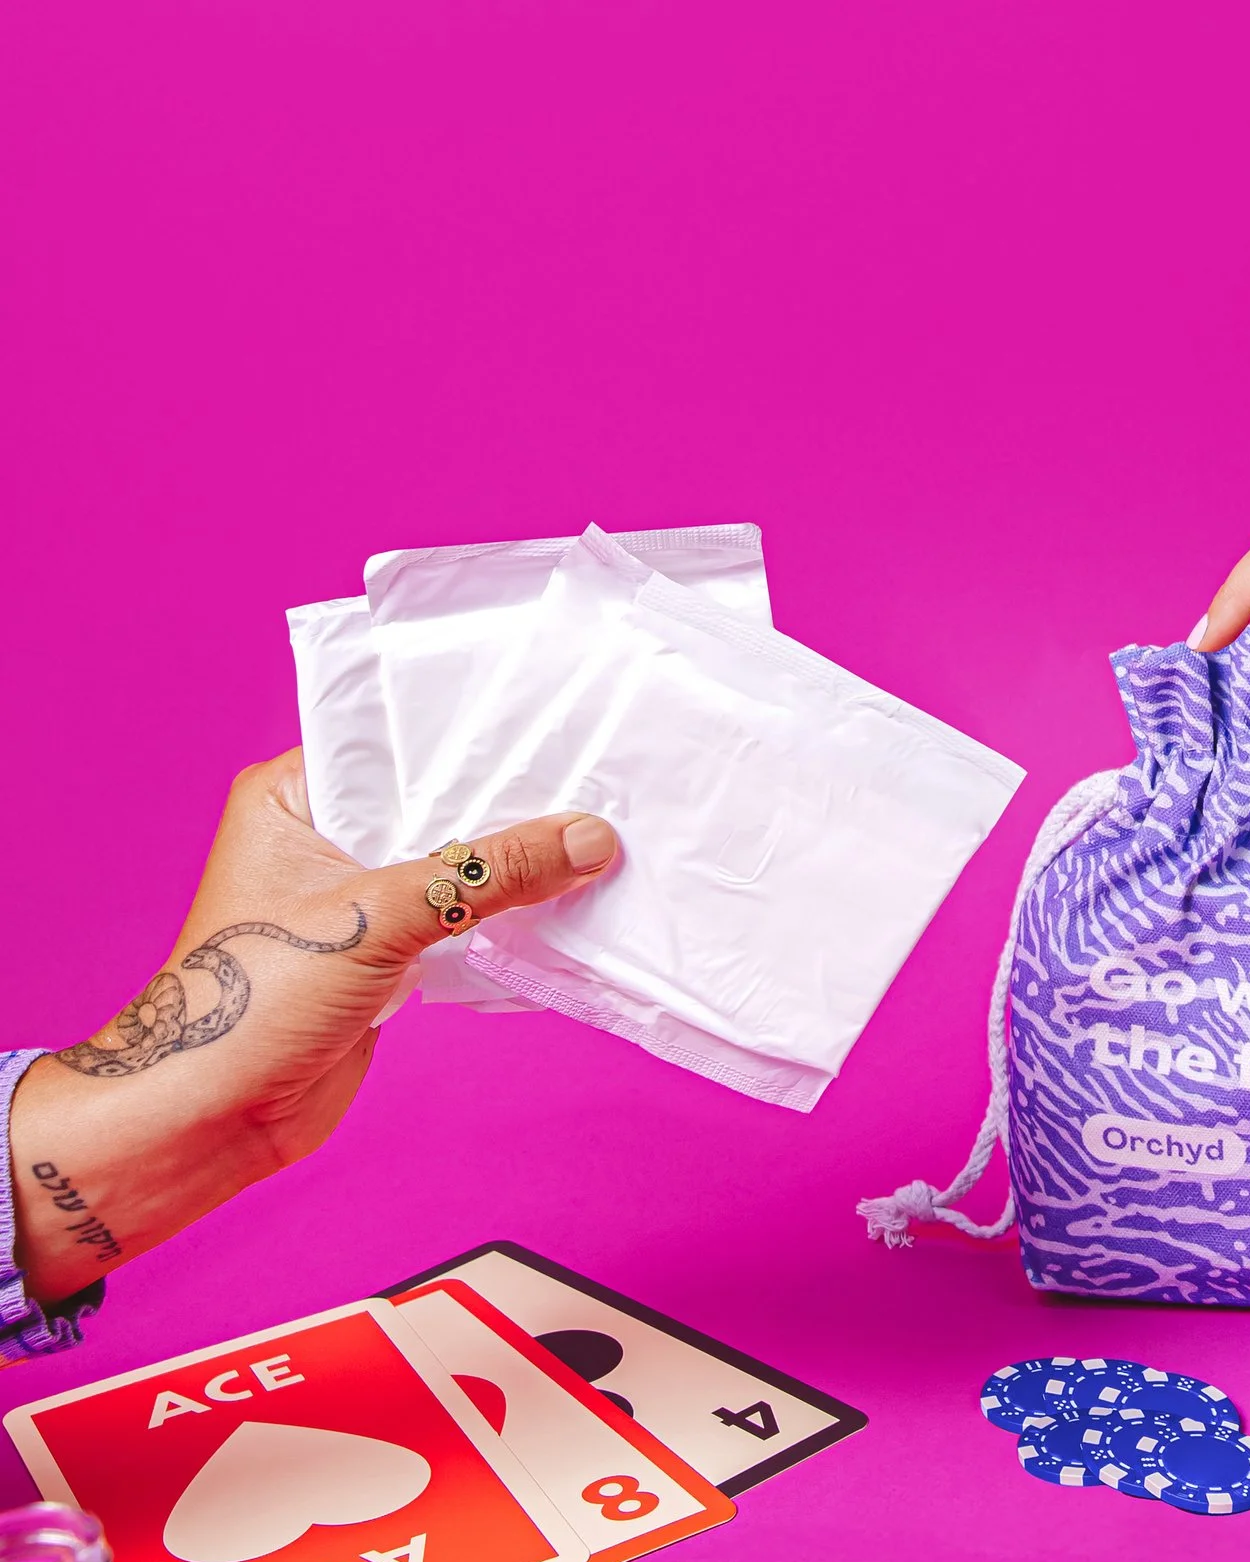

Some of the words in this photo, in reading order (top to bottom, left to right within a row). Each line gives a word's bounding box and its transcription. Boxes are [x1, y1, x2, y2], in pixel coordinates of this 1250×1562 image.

[1089, 955, 1197, 1006] Go
[1090, 1022, 1217, 1083] the
[1102, 1126, 1224, 1166] Orchyd
[146, 1353, 305, 1430] ACE
[710, 1399, 782, 1442] 4
[581, 1474, 660, 1522] 8
